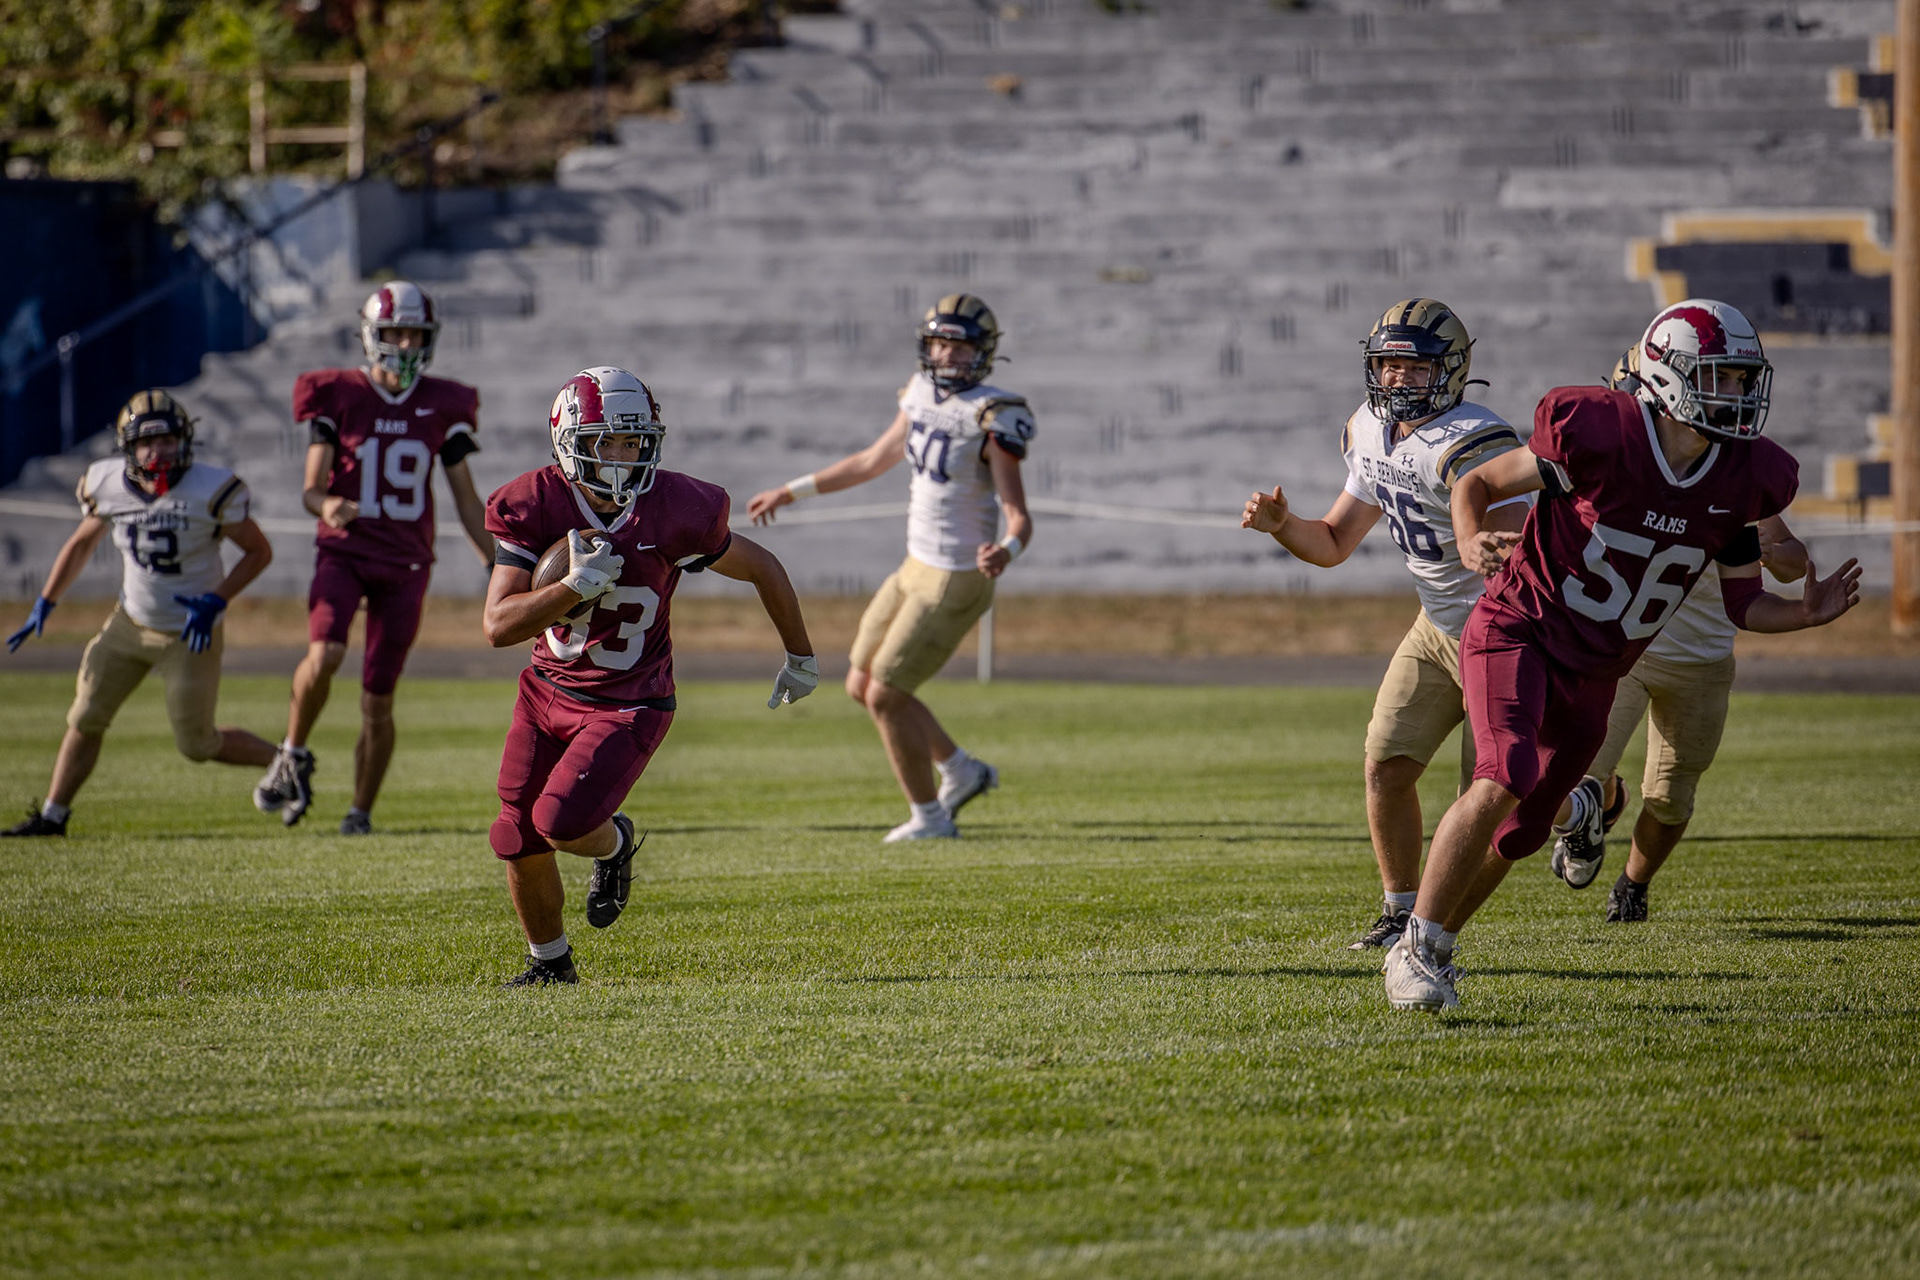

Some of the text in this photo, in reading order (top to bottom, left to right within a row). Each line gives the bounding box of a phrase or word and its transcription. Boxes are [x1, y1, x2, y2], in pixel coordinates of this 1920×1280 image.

[375, 418, 408, 434] RAMS
[355, 437, 431, 521] 19
[127, 524, 182, 574] 12
[1376, 483, 1444, 562] 66
[1642, 510, 1688, 535] RAMS
[1561, 521, 1706, 640] 56
